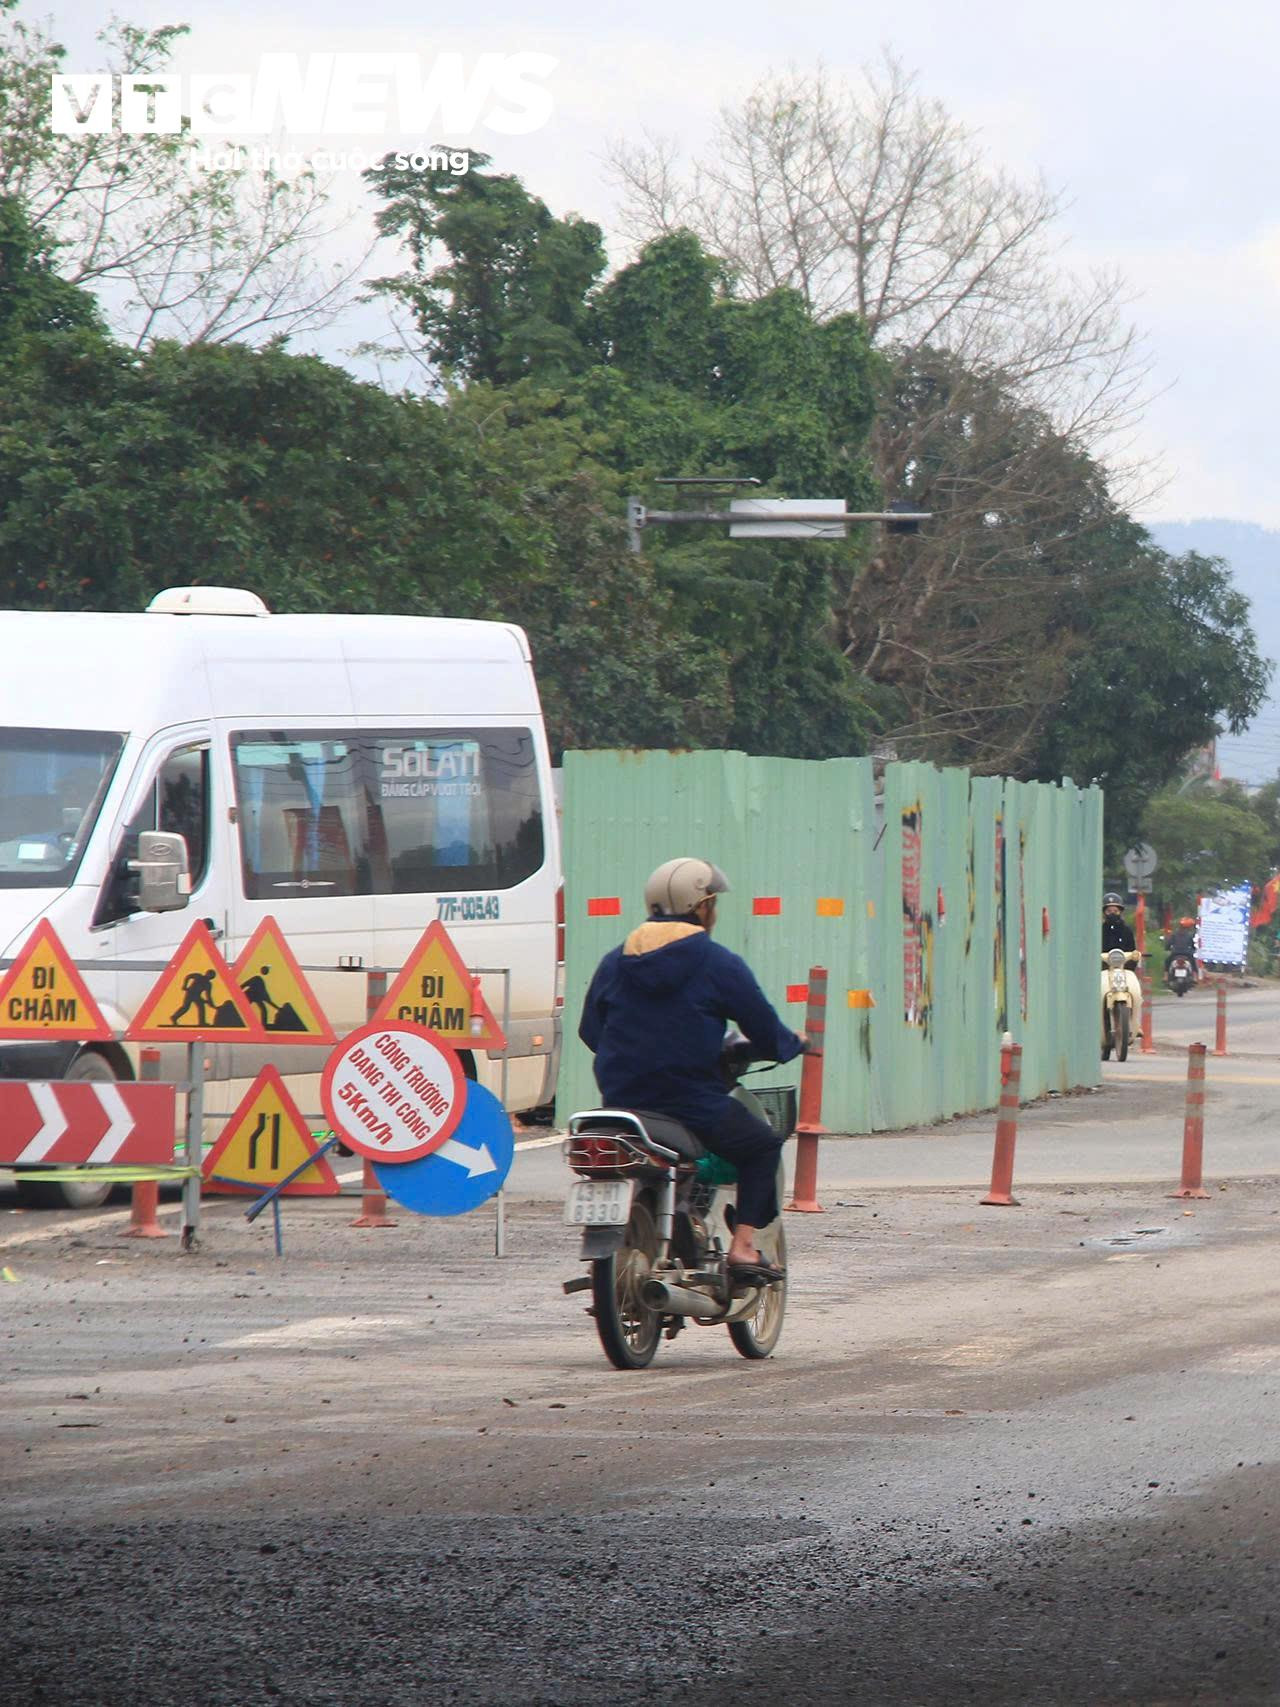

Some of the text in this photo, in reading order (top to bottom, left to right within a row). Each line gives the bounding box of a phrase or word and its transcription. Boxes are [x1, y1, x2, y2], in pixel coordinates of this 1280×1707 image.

[32, 966, 55, 989] ĐI
[421, 976, 444, 998] ĐI
[8, 993, 77, 1027] CHẬM
[374, 1034, 411, 1072] CÔNG
[348, 1048, 431, 1141] ĐANG THI CÔNG
[337, 1081, 394, 1146] 5Km/h
